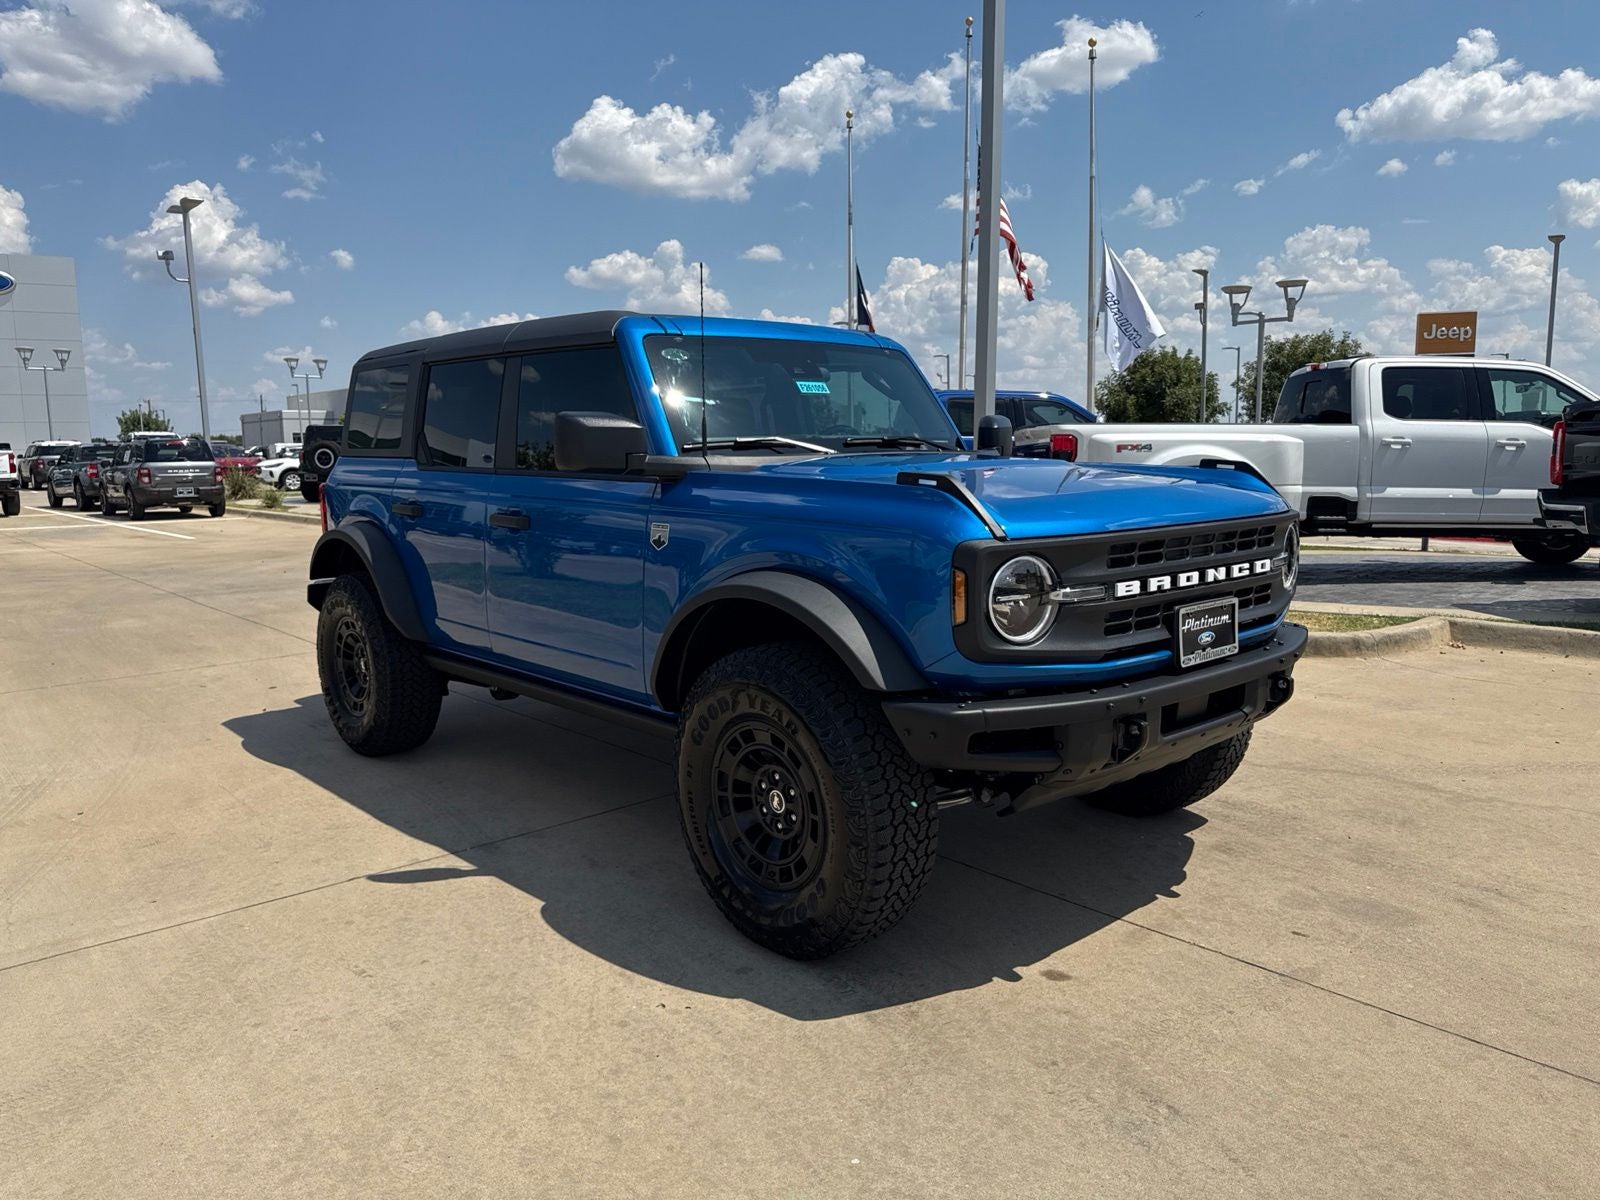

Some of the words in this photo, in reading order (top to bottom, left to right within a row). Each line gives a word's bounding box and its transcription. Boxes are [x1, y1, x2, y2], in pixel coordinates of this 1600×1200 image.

[1423, 323, 1473, 342] Jeep
[1116, 443, 1152, 453] FX4
[1115, 559, 1271, 597] BRONCO
[1182, 615, 1231, 632] Platinum
[1193, 647, 1228, 662] Platinum
[691, 688, 799, 745] GOODYEAR
